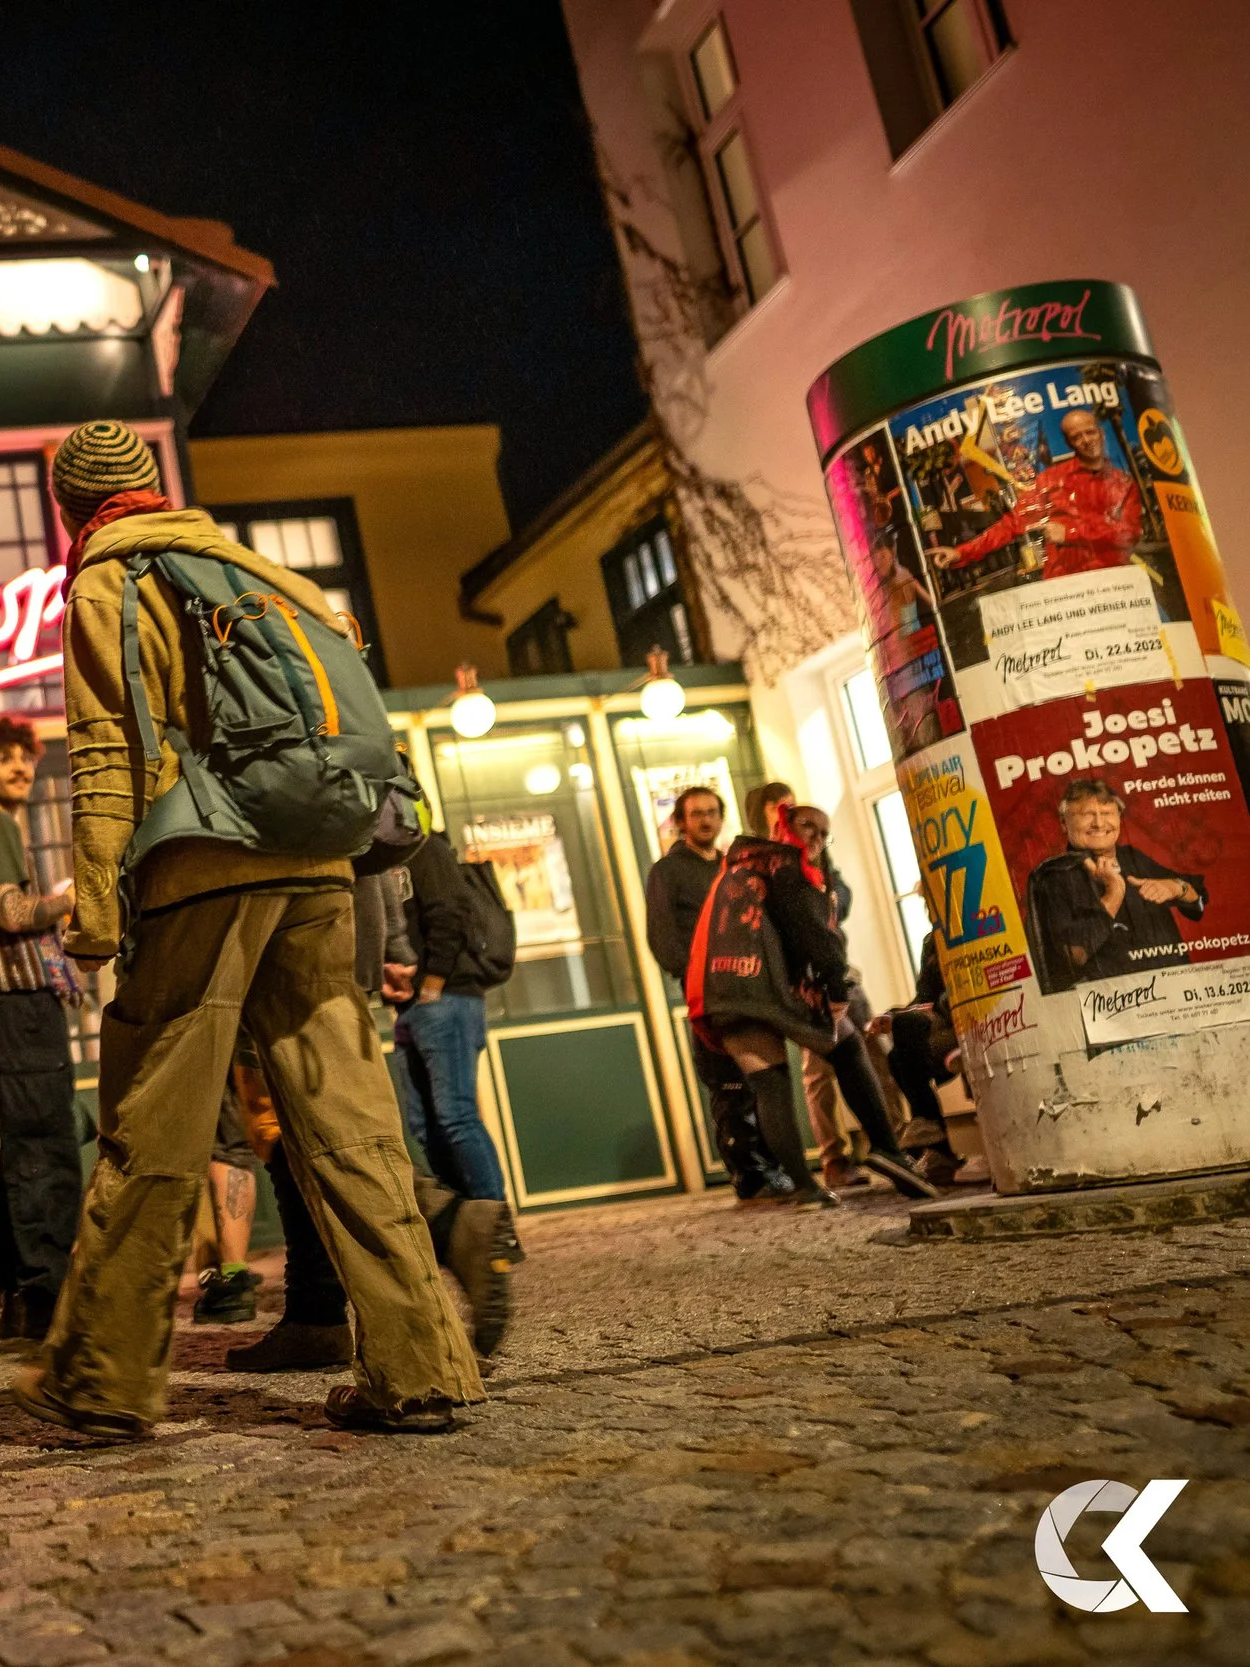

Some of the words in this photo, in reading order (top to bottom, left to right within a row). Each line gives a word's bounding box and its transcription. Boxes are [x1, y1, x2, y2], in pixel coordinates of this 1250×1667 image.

[926, 289, 1102, 381] Metropol
[905, 407, 979, 457] Andy
[984, 388, 1044, 425] Lee
[1046, 381, 1120, 409] Lang
[991, 623, 1015, 638] ANDY
[1017, 619, 1035, 632] LEE
[1037, 612, 1063, 627] LANG
[1066, 608, 1086, 620] UND
[1089, 600, 1128, 615] WERNER
[1129, 597, 1152, 609] AUER
[995, 637, 1072, 683] Metropol
[1106, 638, 1163, 657] 22.6.2023
[1082, 698, 1177, 739] Joesi
[941, 754, 963, 774] AIR
[994, 722, 1218, 790] Prokopetz
[1124, 775, 1176, 795] Pferde
[1177, 772, 1227, 788] können
[1154, 791, 1192, 808] nicht
[1192, 788, 1232, 805] reiten
[1084, 975, 1167, 1022] Metropol
[1183, 988, 1202, 1002] Di,
[964, 992, 1039, 1054] Metropol
